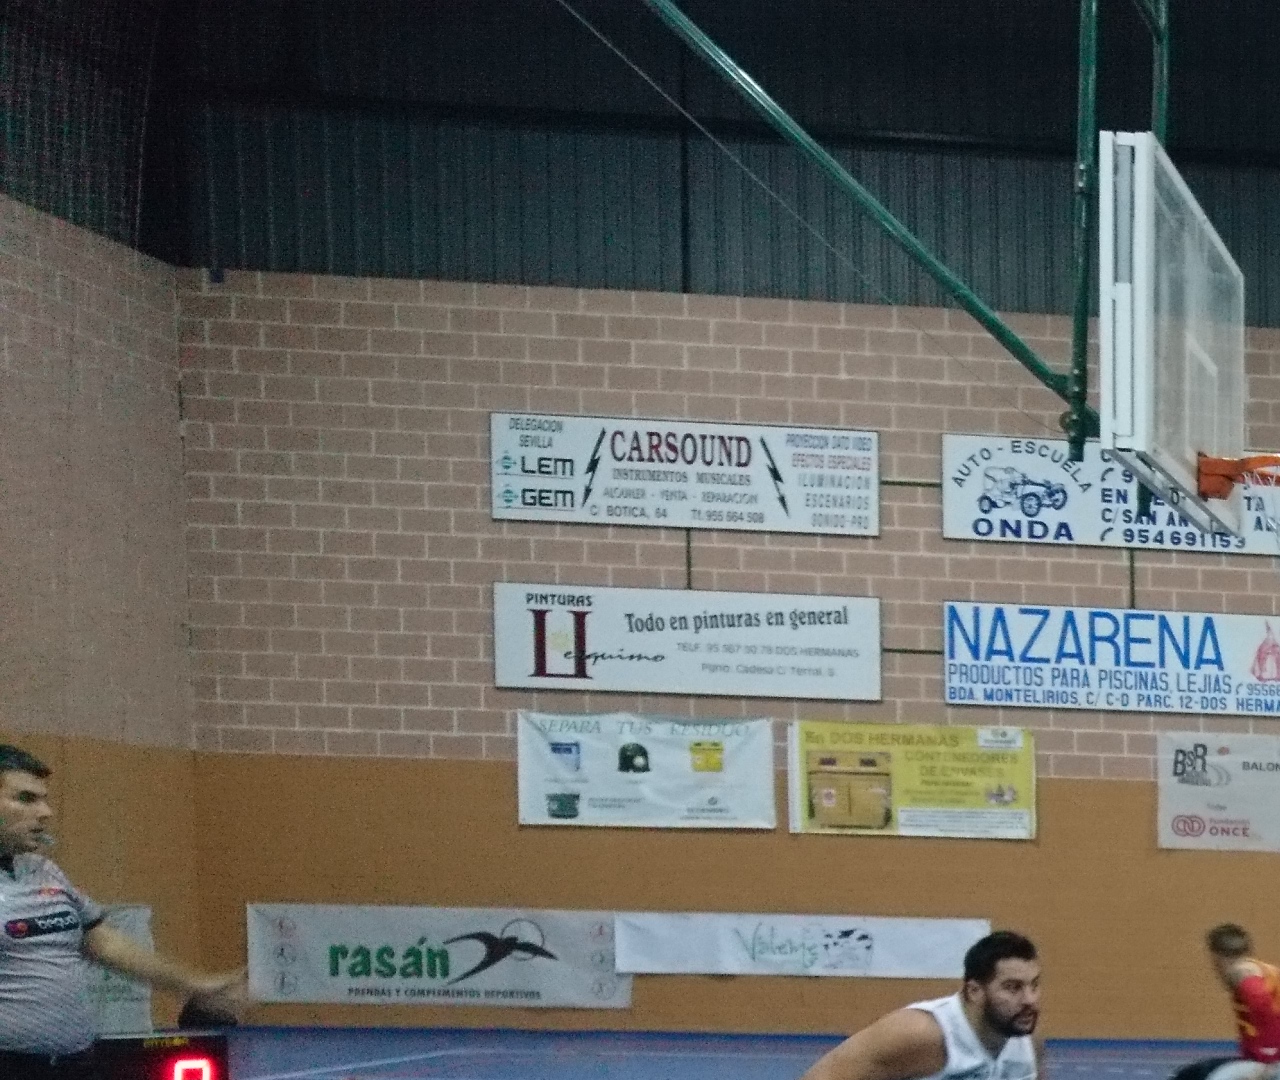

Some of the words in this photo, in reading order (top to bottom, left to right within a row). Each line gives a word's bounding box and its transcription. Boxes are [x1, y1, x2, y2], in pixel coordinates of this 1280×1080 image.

[519, 434, 553, 449] SEVILLA
[609, 429, 752, 468] CARSOUND
[520, 455, 575, 476] LEM
[612, 468, 689, 482] INSTRUMENTOS
[696, 471, 752, 486] MUSICALES
[520, 487, 575, 508] GEM
[805, 492, 869, 510] ESCENARIOS
[972, 517, 1075, 541] ONDA
[525, 592, 593, 607] PINTURAS
[623, 612, 666, 633] Todo
[669, 615, 689, 631] en
[693, 609, 762, 634] pinturas
[765, 610, 785, 627] en
[788, 604, 849, 631] general
[946, 604, 1226, 671] NAZARENA
[798, 646, 860, 659] HERMANAS
[948, 663, 1045, 687] PRODUCTOS
[1050, 666, 1091, 689] PARA
[1176, 672, 1233, 695] LEJIAS
[538, 720, 603, 735] SEPARA
[828, 732, 864, 745] DOS
[868, 733, 960, 748] HERMANAS
[1208, 825, 1251, 838] ONCE
[327, 936, 451, 980] rasán
